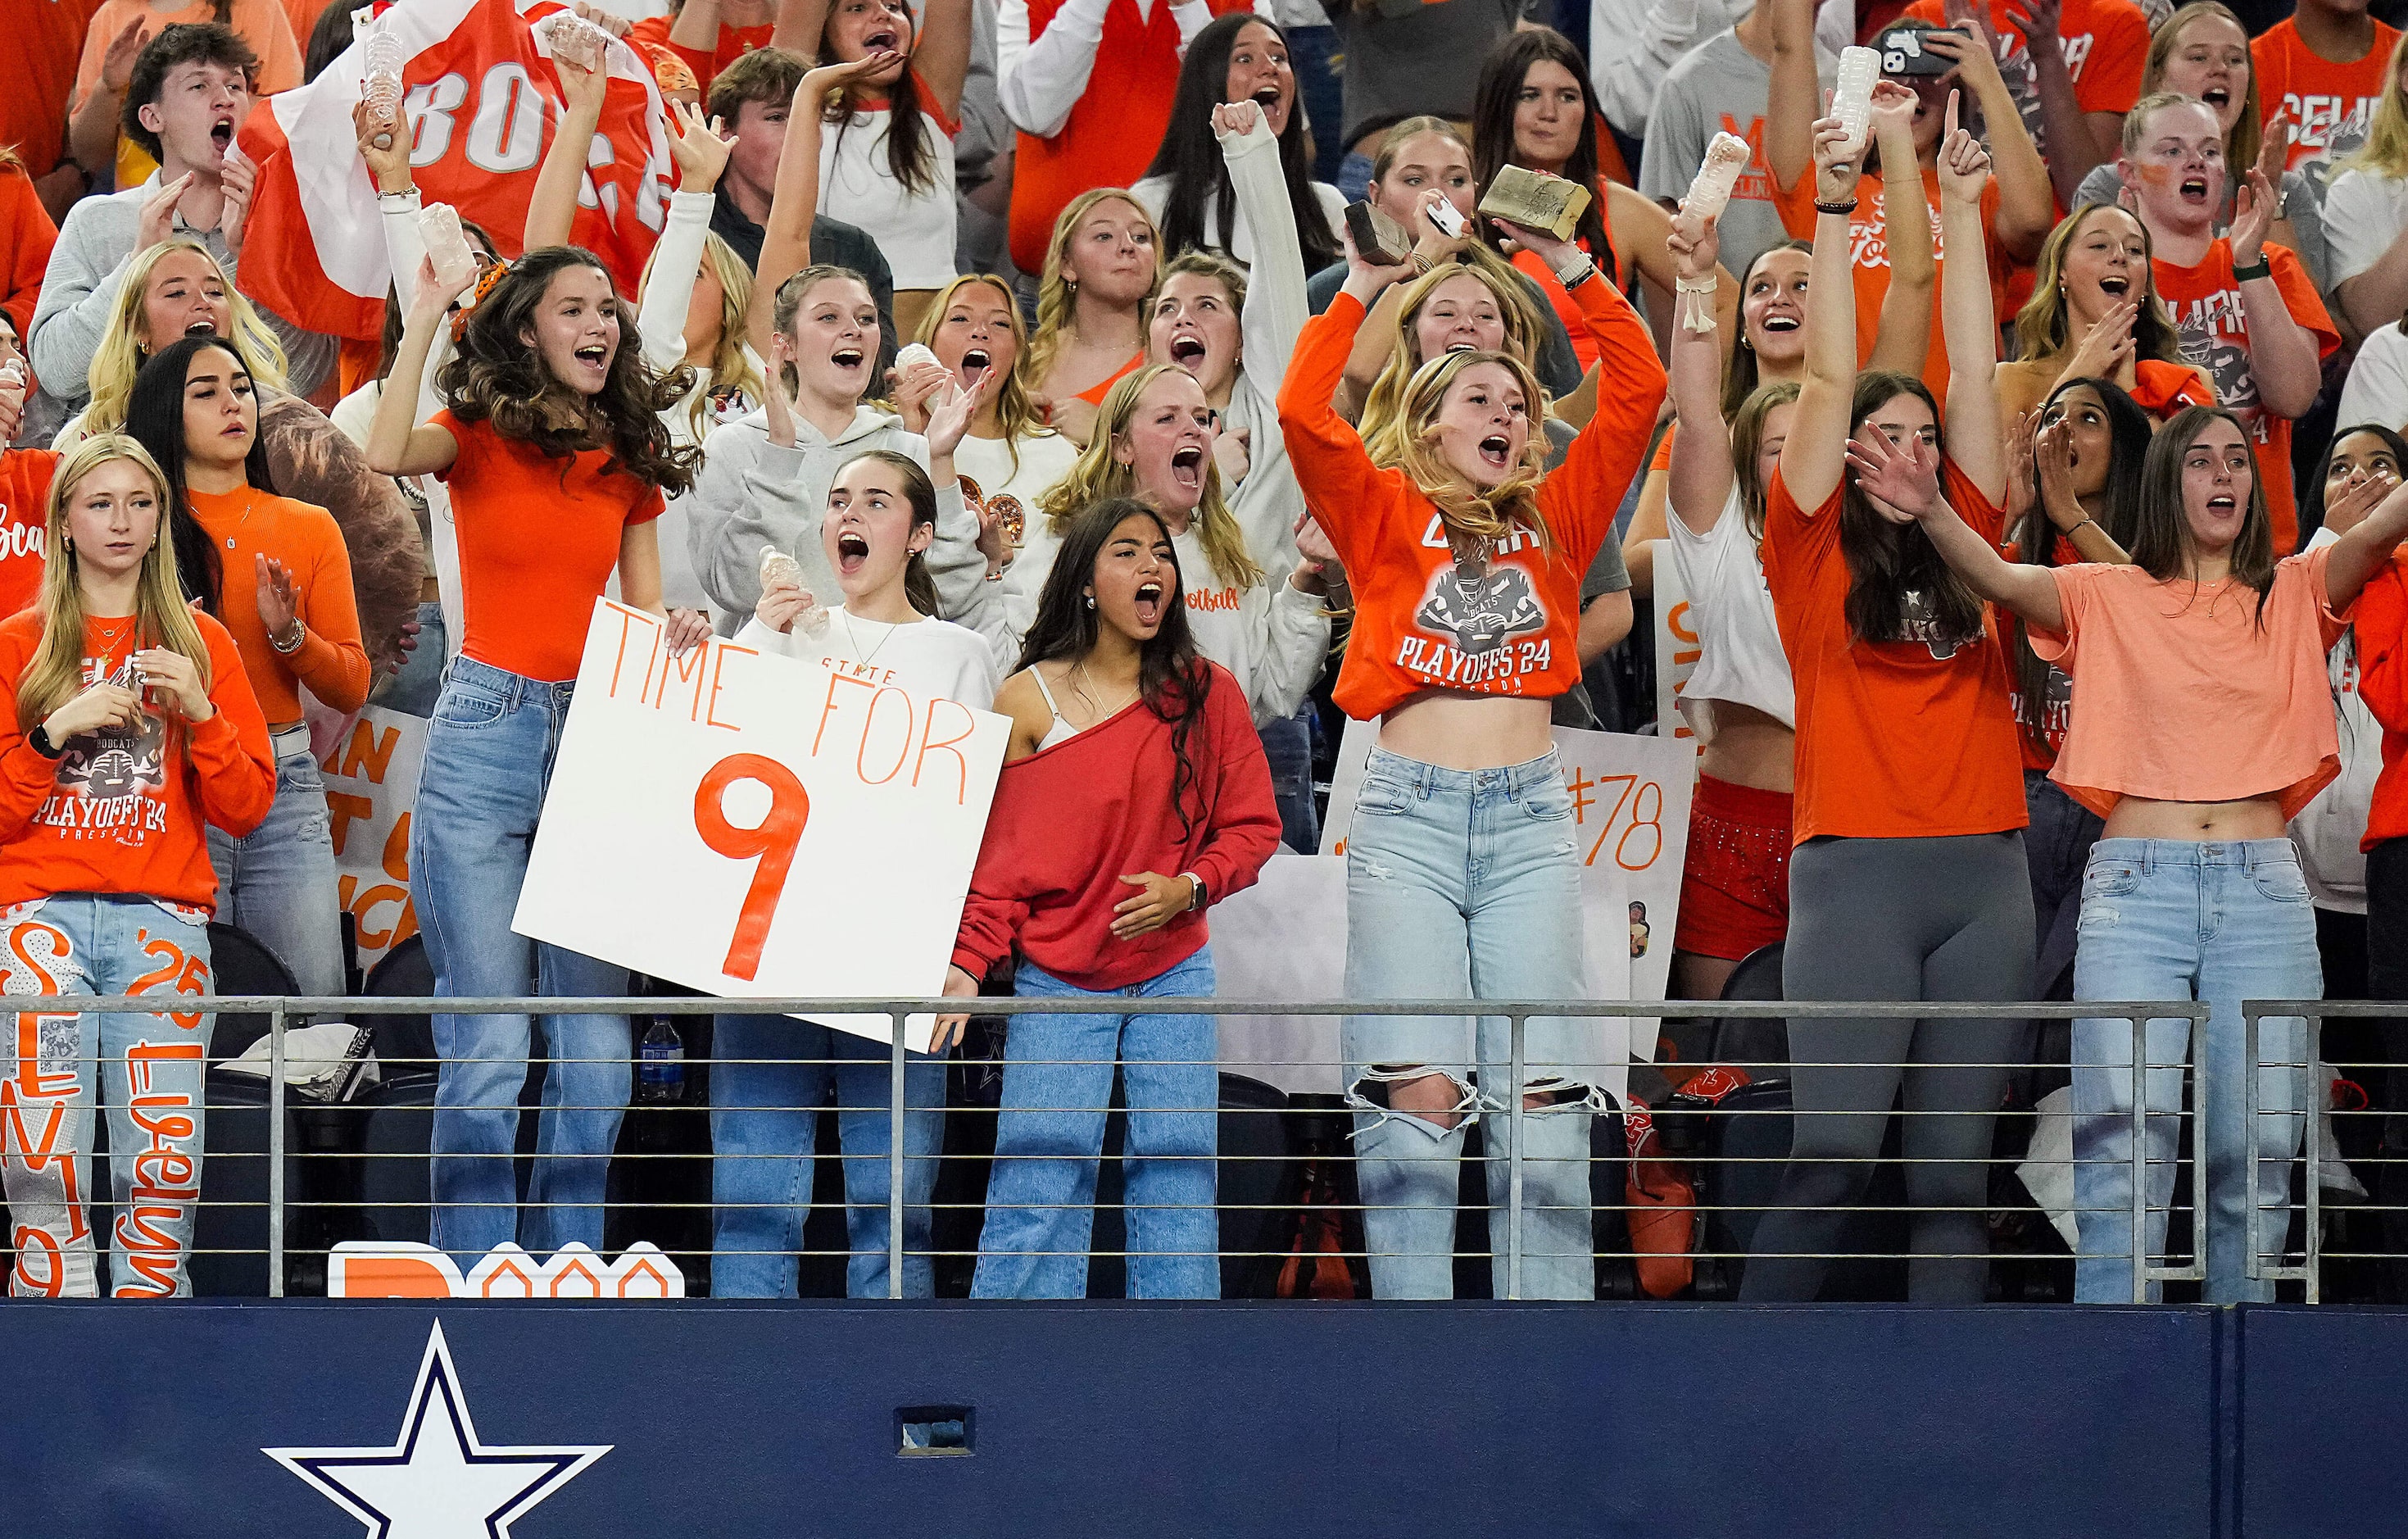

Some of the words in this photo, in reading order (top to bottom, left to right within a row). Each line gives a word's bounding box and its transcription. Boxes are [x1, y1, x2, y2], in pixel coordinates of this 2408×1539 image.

[605, 602, 760, 731] TIME
[812, 673, 975, 805] FOR
[1396, 635, 1514, 684] PLAYOFFS
[1518, 638, 1551, 674] '24
[32, 793, 143, 829] PLAYOFFS
[1567, 766, 1662, 871] #78
[695, 753, 809, 981] 9
